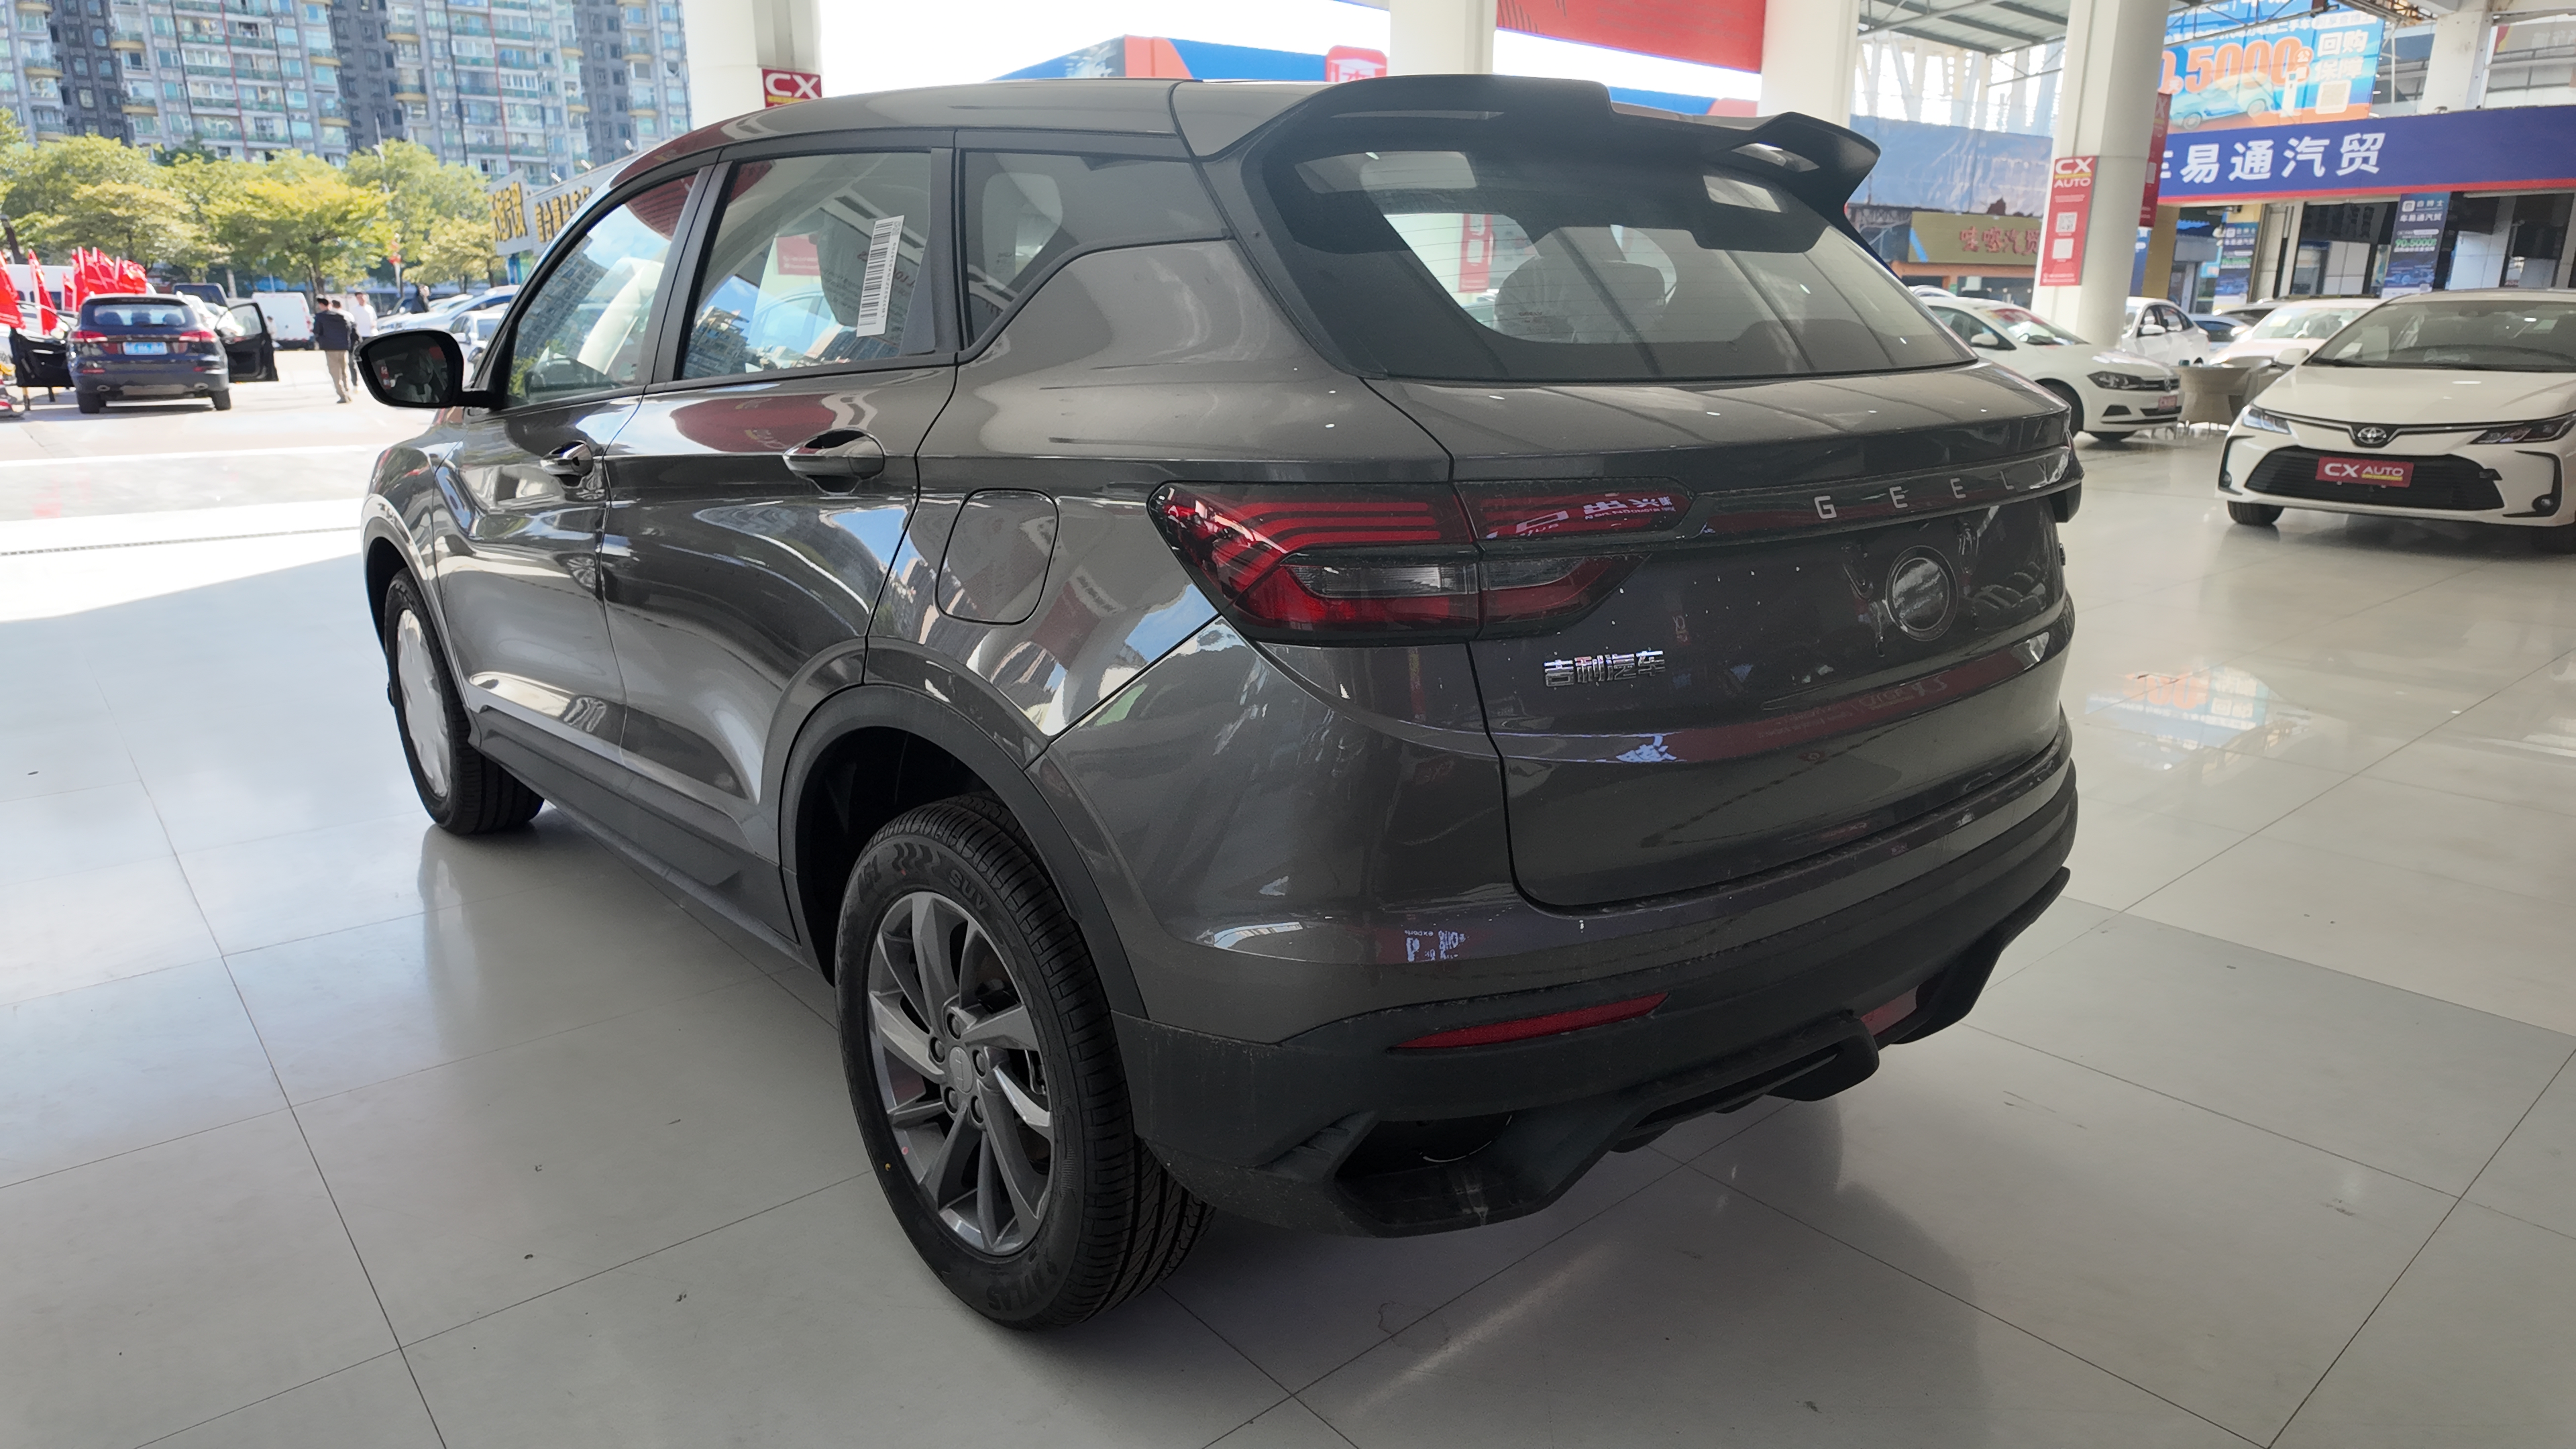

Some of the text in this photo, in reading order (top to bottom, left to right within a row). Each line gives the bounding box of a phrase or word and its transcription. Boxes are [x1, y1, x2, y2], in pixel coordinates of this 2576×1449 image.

[2318, 30, 2369, 58] 回购
[2314, 56, 2364, 82] 保障
[765, 72, 819, 100] CX
[2055, 158, 2092, 174] CX
[2053, 178, 2091, 189] AUTO
[2324, 463, 2359, 478] CX
[2363, 466, 2404, 477] AUTO
[1814, 463, 2049, 519] GEELY
[1544, 650, 1666, 687] 吉利汽车
[949, 869, 989, 910] SUV
